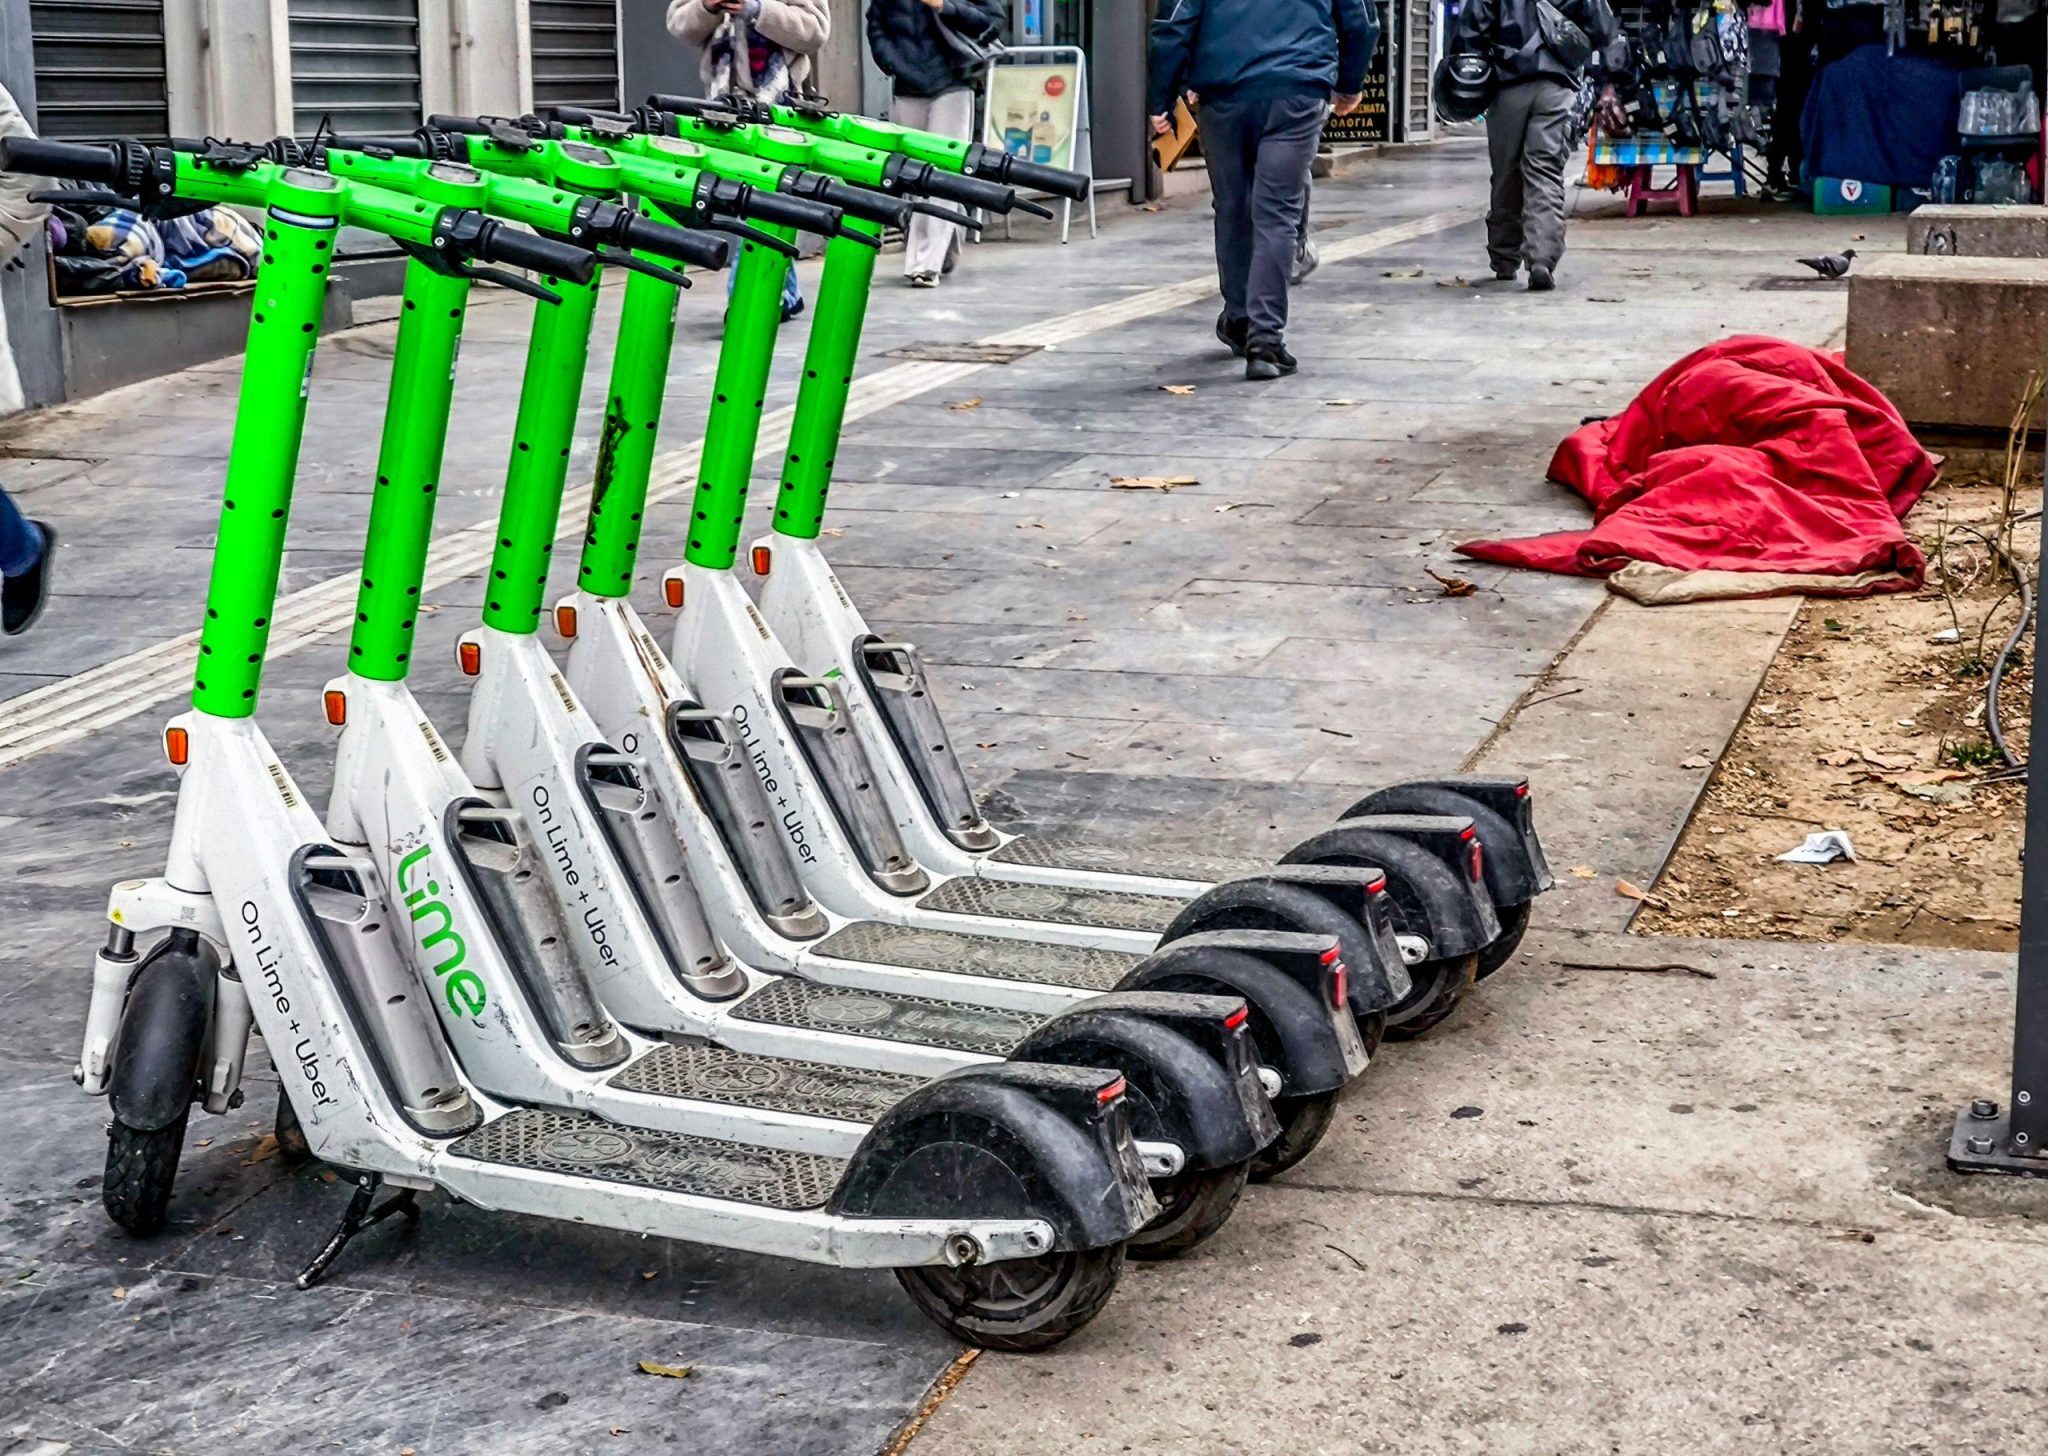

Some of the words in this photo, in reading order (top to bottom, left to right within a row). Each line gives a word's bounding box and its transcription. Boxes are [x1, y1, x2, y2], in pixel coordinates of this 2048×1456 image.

[1364, 74, 1385, 84] OLD
[1330, 117, 1374, 129] ΟΛΟΓΙΑ
[732, 704, 752, 735] On
[782, 810, 818, 864] Uber
[532, 785, 552, 825] On
[546, 825, 580, 887] Lime
[577, 890, 589, 904] +
[583, 907, 619, 968] Uber
[241, 899, 264, 945] On
[255, 944, 291, 1016] Lime
[289, 1017, 301, 1035] +
[293, 1037, 333, 1107] Uber
